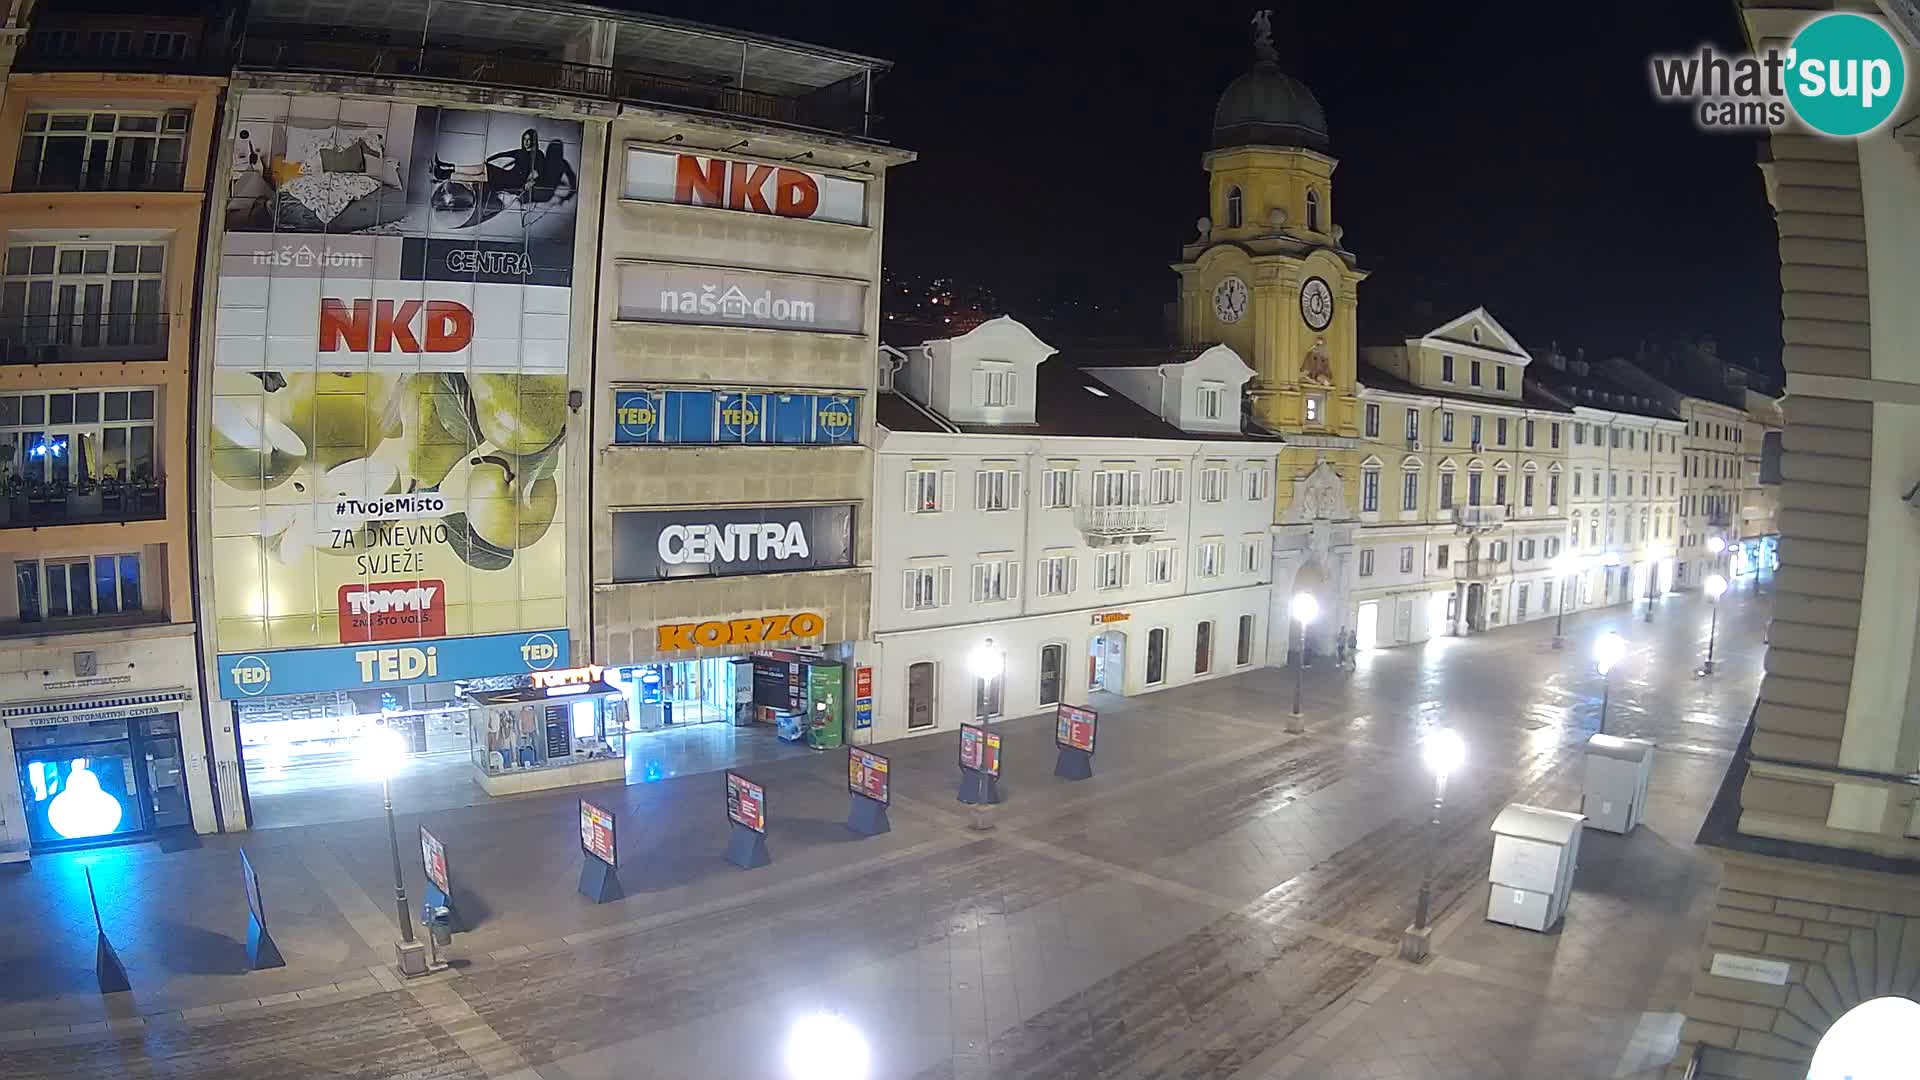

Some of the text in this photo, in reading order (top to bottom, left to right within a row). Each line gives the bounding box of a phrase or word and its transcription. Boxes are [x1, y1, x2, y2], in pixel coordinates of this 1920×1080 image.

[673, 154, 819, 218] NKD
[317, 247, 363, 268] dom
[446, 249, 532, 275] CENTRA
[660, 284, 815, 322] naš dom
[319, 297, 474, 353] NKD
[336, 498, 444, 516] #TvojeMisto
[331, 524, 448, 549] ZA DNEVNO
[658, 521, 809, 564] CENTRA
[357, 548, 424, 575] SVJEŽE
[346, 587, 437, 615] TOMMY
[377, 615, 397, 626] ŠTO
[658, 613, 824, 651] KORZO
[356, 646, 437, 683] TEDi
[521, 643, 558, 661] TEDi
[231, 666, 271, 685] TEDi
[530, 663, 604, 688] TOMMY
[129, 707, 159, 717] CENTAR
